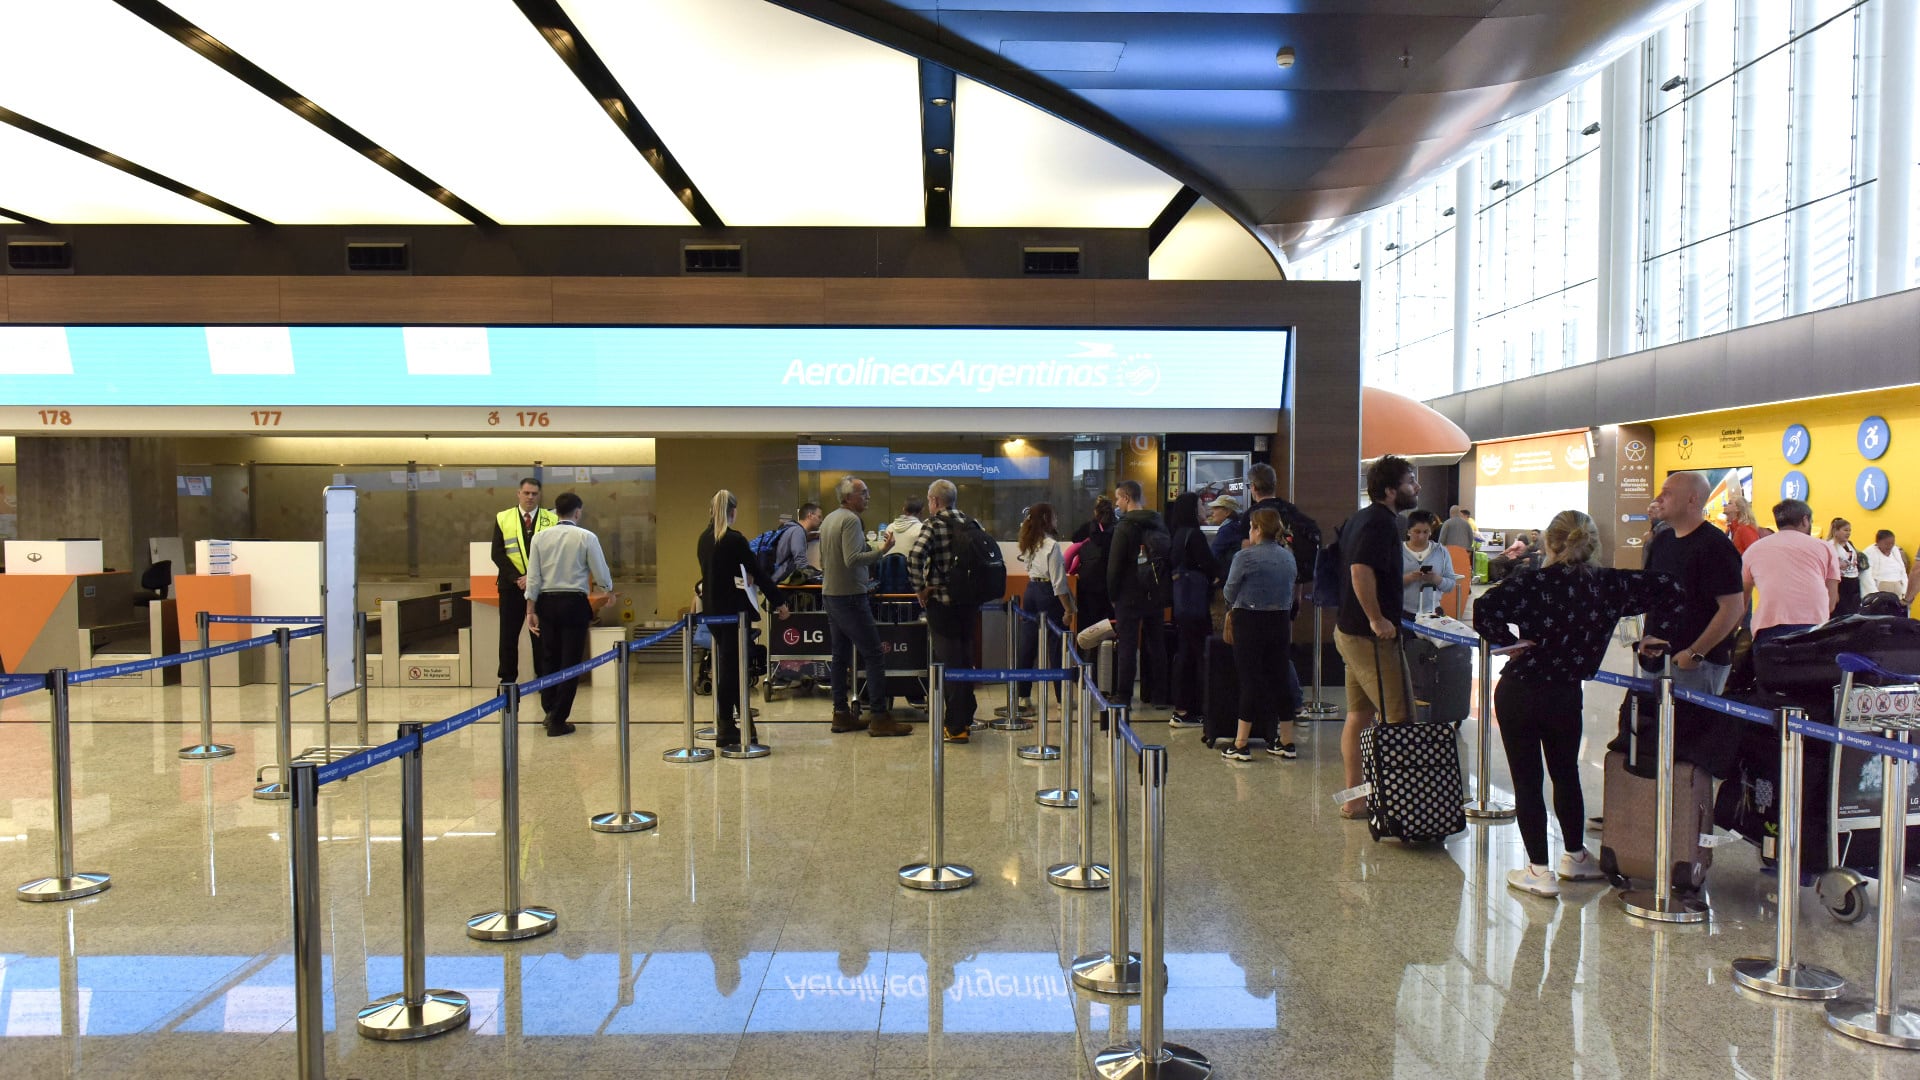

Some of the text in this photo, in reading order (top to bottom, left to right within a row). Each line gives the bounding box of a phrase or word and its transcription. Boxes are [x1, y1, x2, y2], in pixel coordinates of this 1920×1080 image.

[38, 410, 72, 426] 178
[250, 411, 282, 426] 177
[516, 411, 550, 427] 176
[803, 630, 824, 643] LG
[893, 642, 908, 652] LG
[1846, 735, 1872, 747] despegar
[1910, 797, 1919, 805] LG
